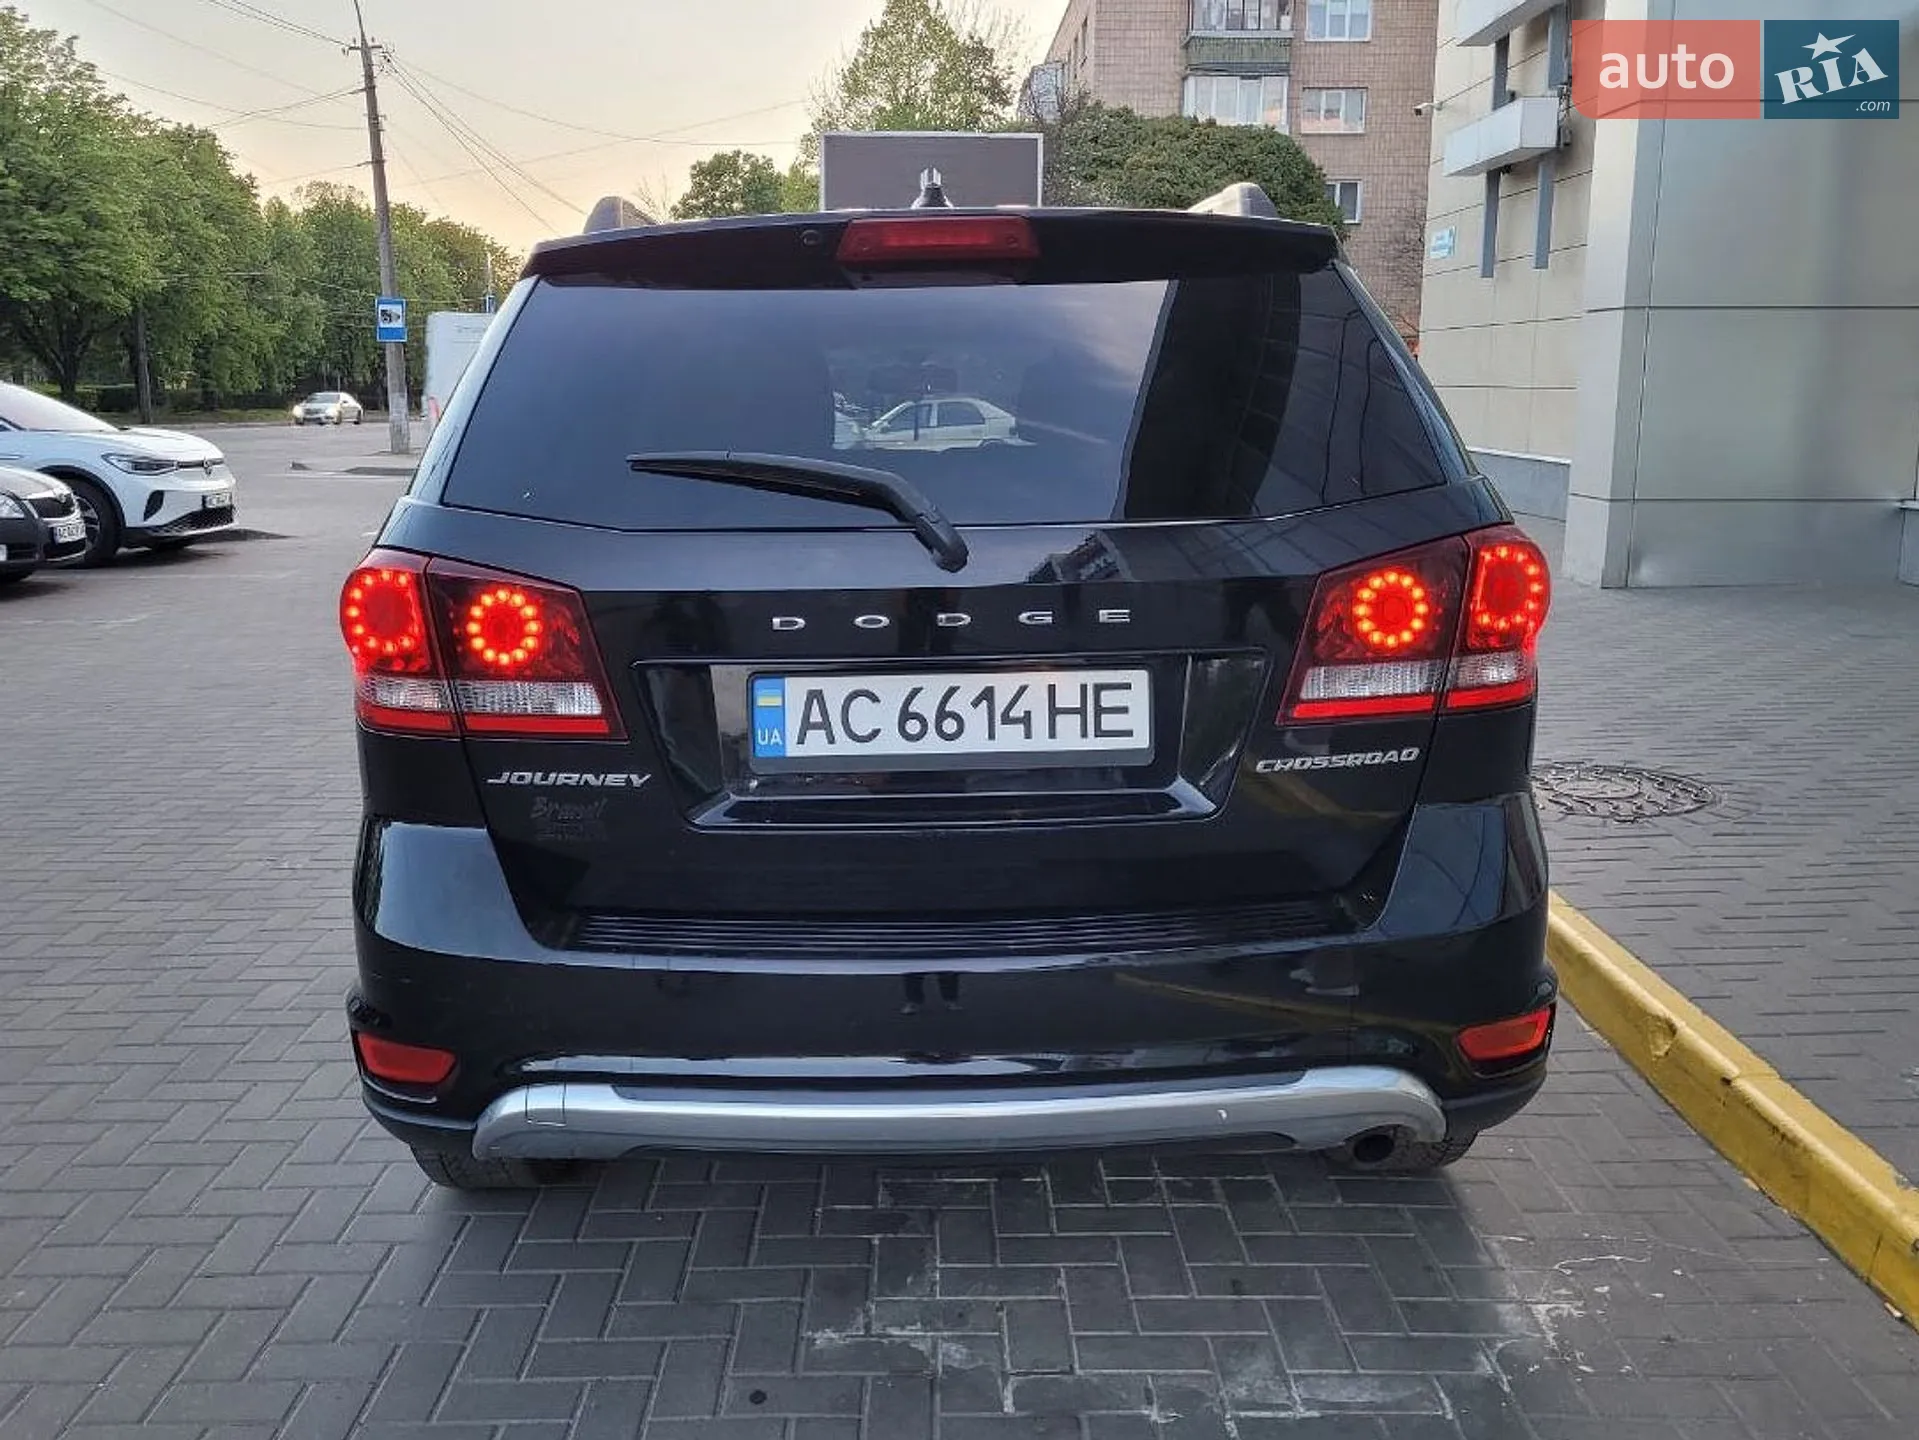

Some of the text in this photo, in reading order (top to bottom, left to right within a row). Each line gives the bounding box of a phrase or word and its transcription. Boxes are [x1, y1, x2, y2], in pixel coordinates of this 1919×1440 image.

[772, 609, 1131, 631] DODGE
[796, 682, 1134, 745] AC 6614 HE
[757, 730, 783, 746] UA
[1256, 747, 1420, 773] CROSSROAD
[487, 771, 652, 788] JOURNEY
